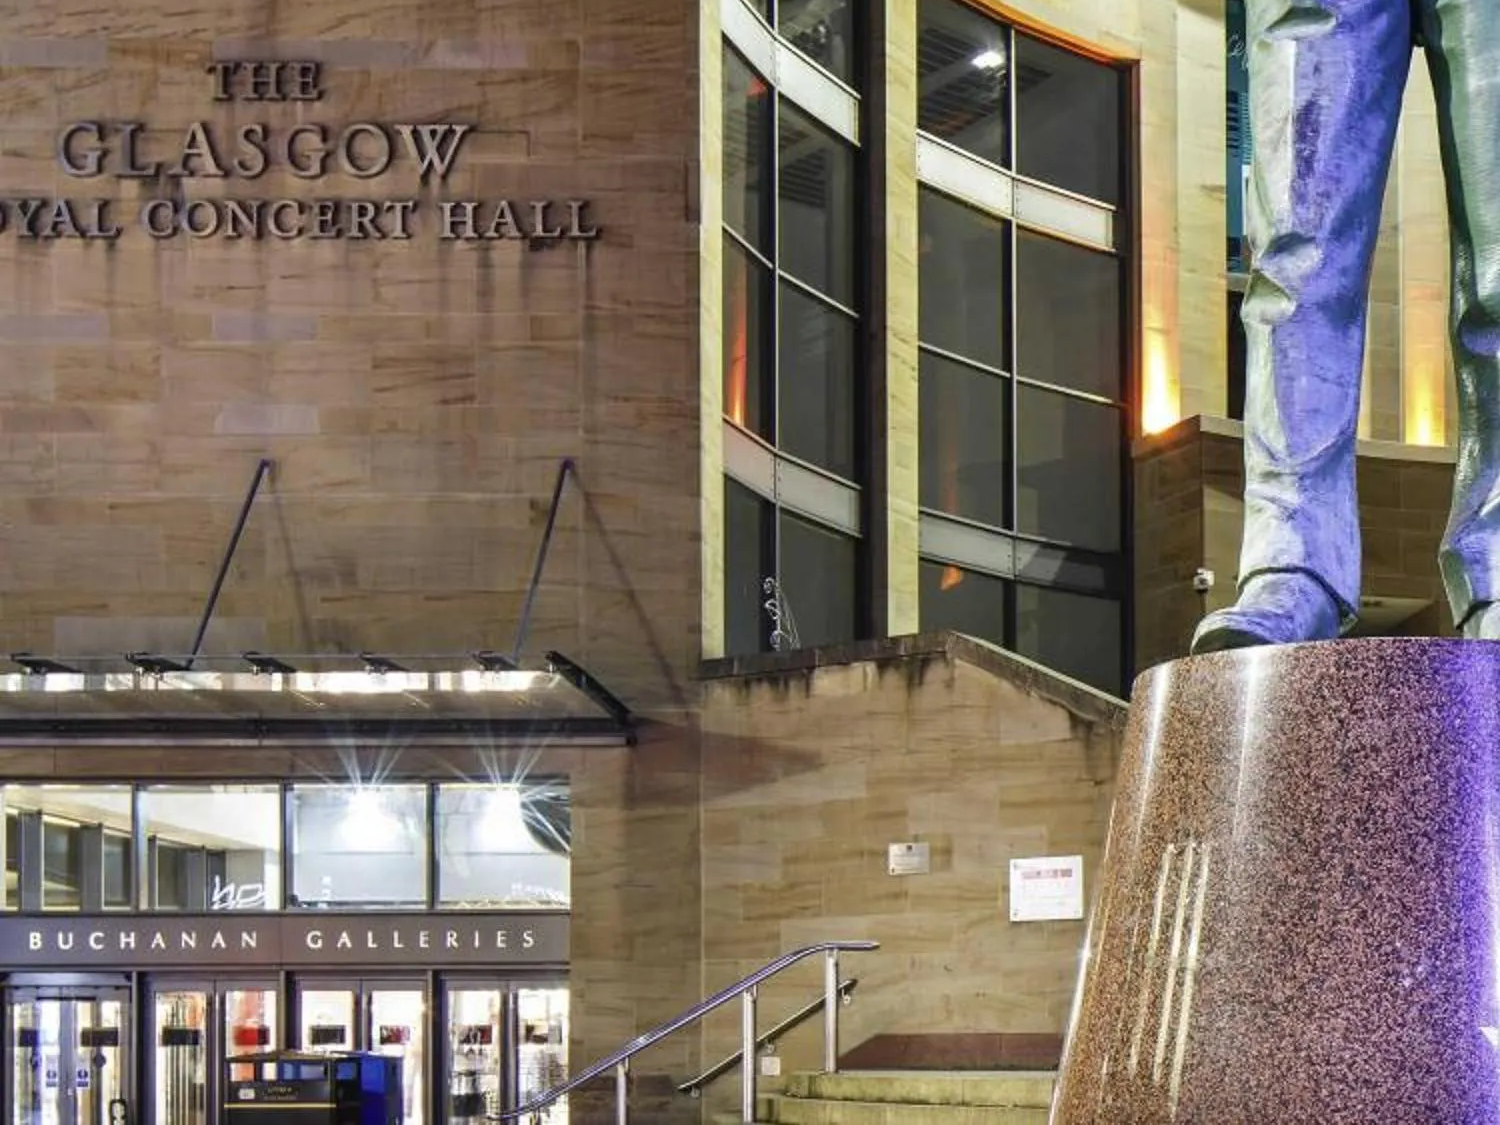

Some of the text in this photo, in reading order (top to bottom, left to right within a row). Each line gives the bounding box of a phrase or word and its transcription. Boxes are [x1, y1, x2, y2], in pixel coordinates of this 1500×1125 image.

[207, 60, 325, 103] THE
[59, 121, 470, 179] GLASGOW
[0, 199, 602, 240] YAL CONCERT HALL
[28, 929, 536, 951] BUCHANAN GALLERIES
